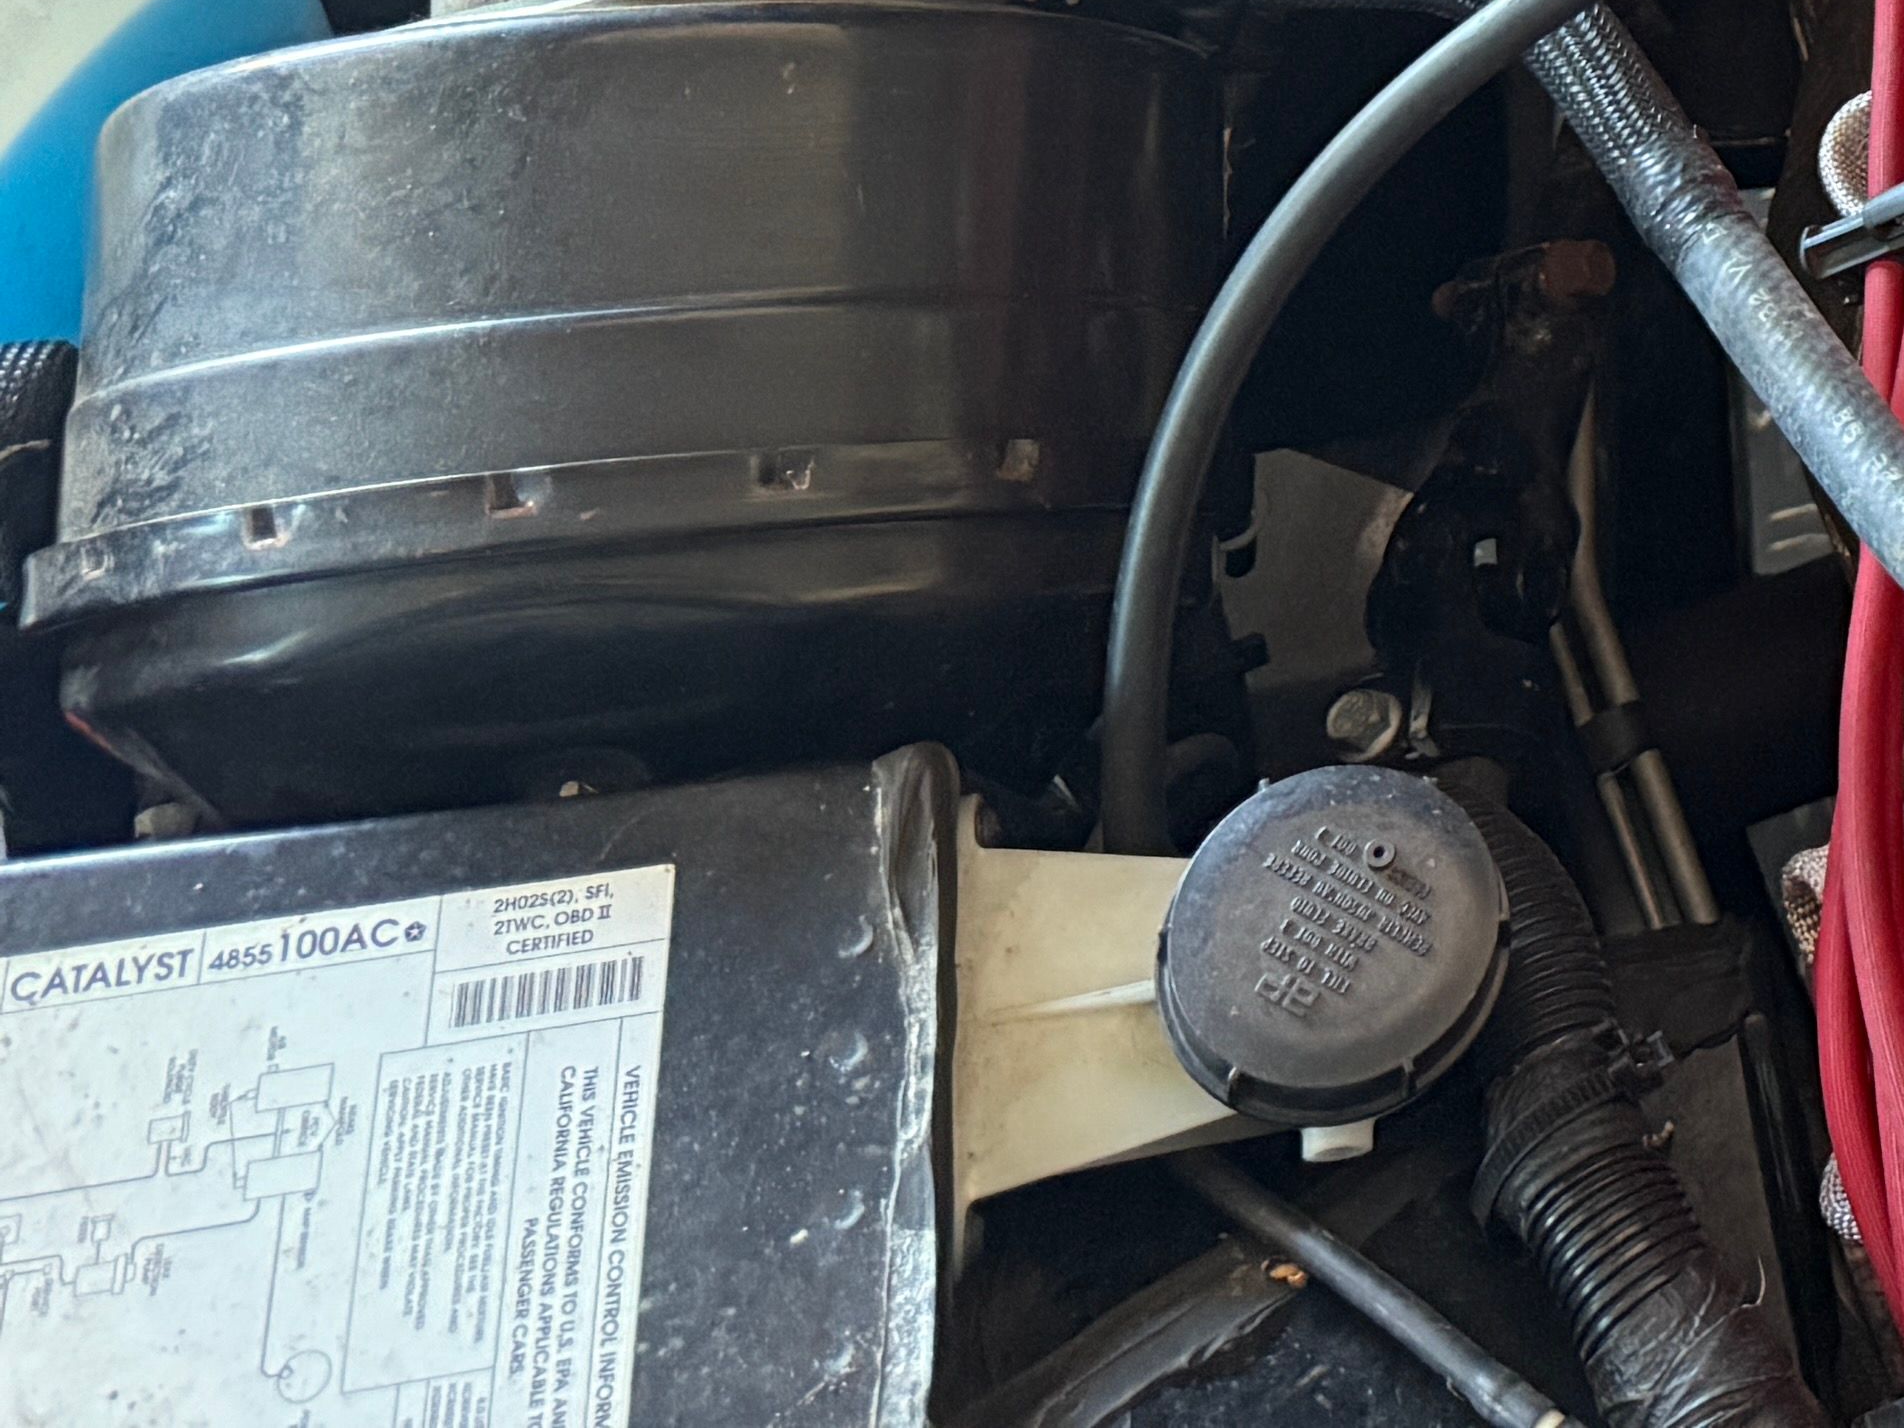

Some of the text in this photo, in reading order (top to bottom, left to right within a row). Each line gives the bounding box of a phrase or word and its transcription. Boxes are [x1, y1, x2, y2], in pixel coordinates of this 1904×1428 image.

[11, 918, 400, 1003] CATALYST 4855100AC
[494, 916, 550, 936] 2TWC,
[554, 908, 594, 927] OBD
[506, 929, 594, 956] CERTIFIED
[552, 1064, 576, 1171] CALIFORNIA
[581, 1066, 598, 1101] THIS
[618, 1065, 640, 1144] VEHICLE
[573, 1105, 595, 1177] VEHICLE
[540, 1175, 564, 1296] REGULATIONS
[563, 1181, 586, 1286] CONFORMS
[610, 1149, 632, 1244] EMISSION
[508, 1217, 538, 1377] PASSENGER CARS.
[556, 1319, 574, 1352] U.S.
[560, 1290, 576, 1315] TO
[600, 1248, 623, 1347] CONTROL
[529, 1300, 553, 1408] APPLICABLE
[553, 1357, 571, 1390] EPA
